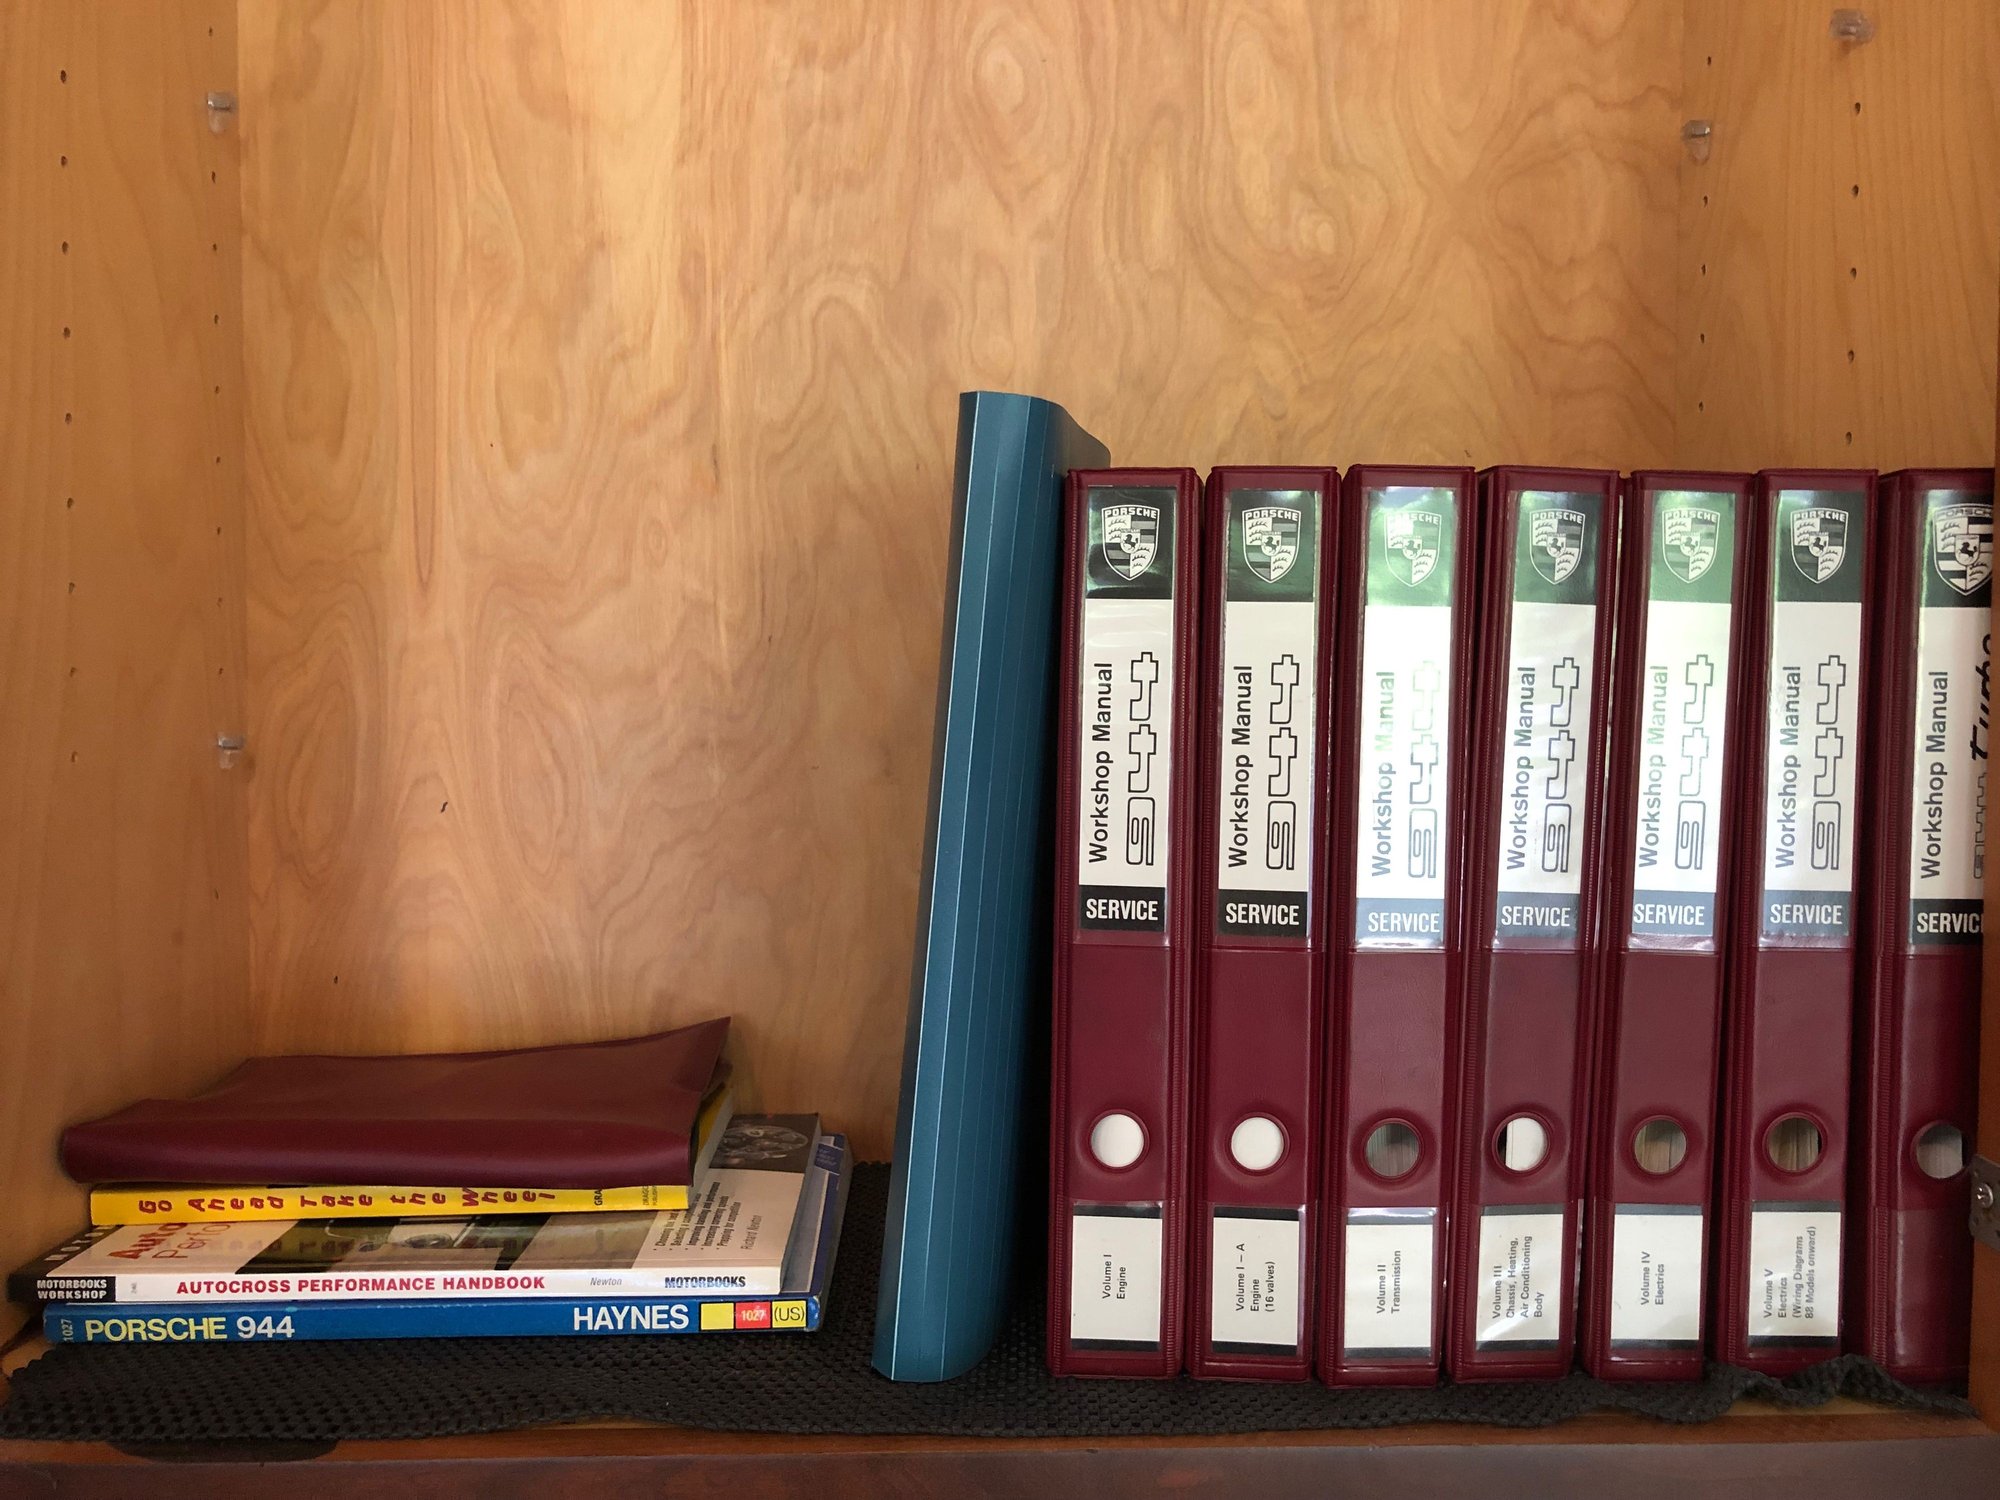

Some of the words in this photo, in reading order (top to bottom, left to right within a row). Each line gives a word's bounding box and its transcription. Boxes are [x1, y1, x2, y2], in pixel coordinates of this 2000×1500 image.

[1104, 507, 1157, 519] PORSCHE
[1244, 509, 1299, 522] PORSCHE
[1532, 511, 1583, 524] PORSCHE
[1665, 510, 1718, 523] PORSCHE
[1793, 510, 1846, 522] PORSCHE
[1092, 663, 1112, 742] Manual
[1232, 666, 1252, 745] Manual
[1375, 672, 1395, 752] Manual
[1513, 667, 1536, 747] Manual
[1647, 666, 1668, 745] Manual
[1780, 666, 1801, 746] Manual
[1926, 671, 1948, 753] Manual
[1088, 751, 1113, 863] Workshop
[1228, 755, 1253, 867] Workshop
[1371, 762, 1397, 876] Workshop
[1506, 756, 1534, 870] Workshop
[1639, 754, 1664, 867] Workshop
[1775, 755, 1800, 868] Workshop
[1921, 762, 1947, 879] Workshop
[1086, 899, 1158, 920] SERVICE
[1226, 903, 1299, 925] SERVICE
[1368, 912, 1440, 932] SERVICE
[1501, 906, 1570, 927] SERVICE
[1634, 904, 1705, 925] SERVICE
[1770, 904, 1843, 925] SERVICE
[1917, 912, 1984, 934] SERVIC
[138, 1200, 172, 1214] Go
[188, 1196, 284, 1211] Ahead
[300, 1194, 373, 1208] Take
[390, 1191, 446, 1205] the
[463, 1187, 556, 1207] Wheel
[1236, 1243, 1245, 1252] A
[1508, 1238, 1518, 1278] Heating,
[1641, 1251, 1650, 1264] IV
[1794, 1236, 1804, 1282] Diagrams
[1807, 1226, 1817, 1267] onward)
[590, 1276, 622, 1287] Newton
[664, 1275, 746, 1290] MOTORBOOKS
[1102, 1261, 1111, 1299] Volume
[1117, 1266, 1127, 1300] Engine
[1265, 1261, 1275, 1293] valves)
[1377, 1264, 1386, 1273] II
[1391, 1250, 1401, 1314] Transmission
[1521, 1235, 1532, 1299] Conditioning
[1763, 1268, 1773, 1277] V
[37, 1279, 107, 1289] MOTORBOOKS
[37, 1290, 107, 1300] WORKSHOP
[176, 1276, 291, 1295] AUTOCROSS
[298, 1277, 436, 1293] PERFORMANCE
[442, 1275, 546, 1291] HANDBOOK
[1236, 1273, 1245, 1311] Volume
[1250, 1279, 1261, 1312] Engine
[1377, 1275, 1386, 1314] Volume
[1492, 1280, 1501, 1319] Volume
[1506, 1281, 1516, 1318] Chassis,
[1641, 1267, 1649, 1305] Volume
[1655, 1263, 1664, 1305] Electrics
[1763, 1280, 1772, 1318] Volume
[1778, 1277, 1787, 1318] Electrics
[1806, 1270, 1815, 1304] Models
[741, 1309, 766, 1322] 1027
[773, 1306, 806, 1323] (US)
[1265, 1295, 1275, 1312] (16
[1520, 1302, 1529, 1318] Air
[1534, 1291, 1544, 1318] Body
[1792, 1284, 1802, 1318] (Wiring
[1805, 1306, 1814, 1319] 88
[61, 1318, 73, 1342] 1027
[85, 1317, 228, 1342] PORSCHE
[236, 1316, 295, 1338] 944
[573, 1304, 689, 1331] HAYNES
